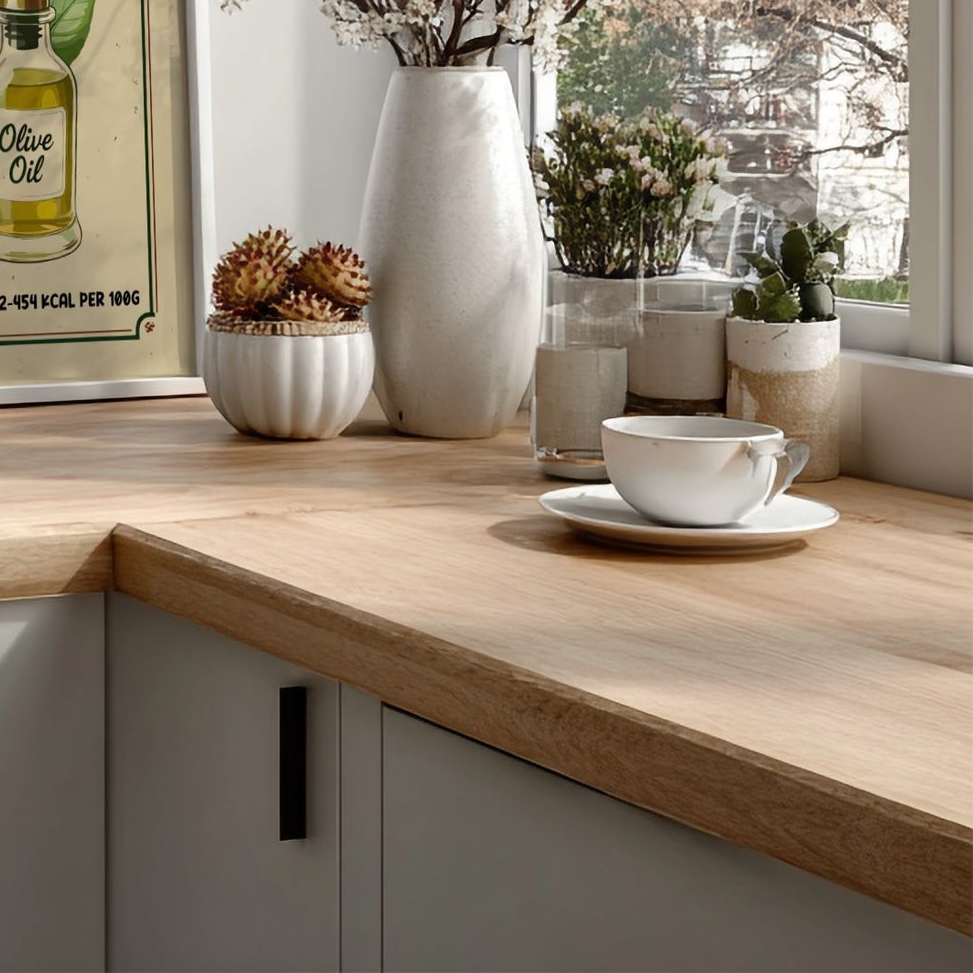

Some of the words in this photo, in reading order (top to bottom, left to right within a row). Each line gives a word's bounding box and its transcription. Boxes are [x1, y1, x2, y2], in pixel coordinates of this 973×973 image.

[9, 154, 45, 184] Oil
[41, 292, 76, 309] KCAL
[79, 291, 105, 308] PER
[108, 289, 140, 307] 100G
